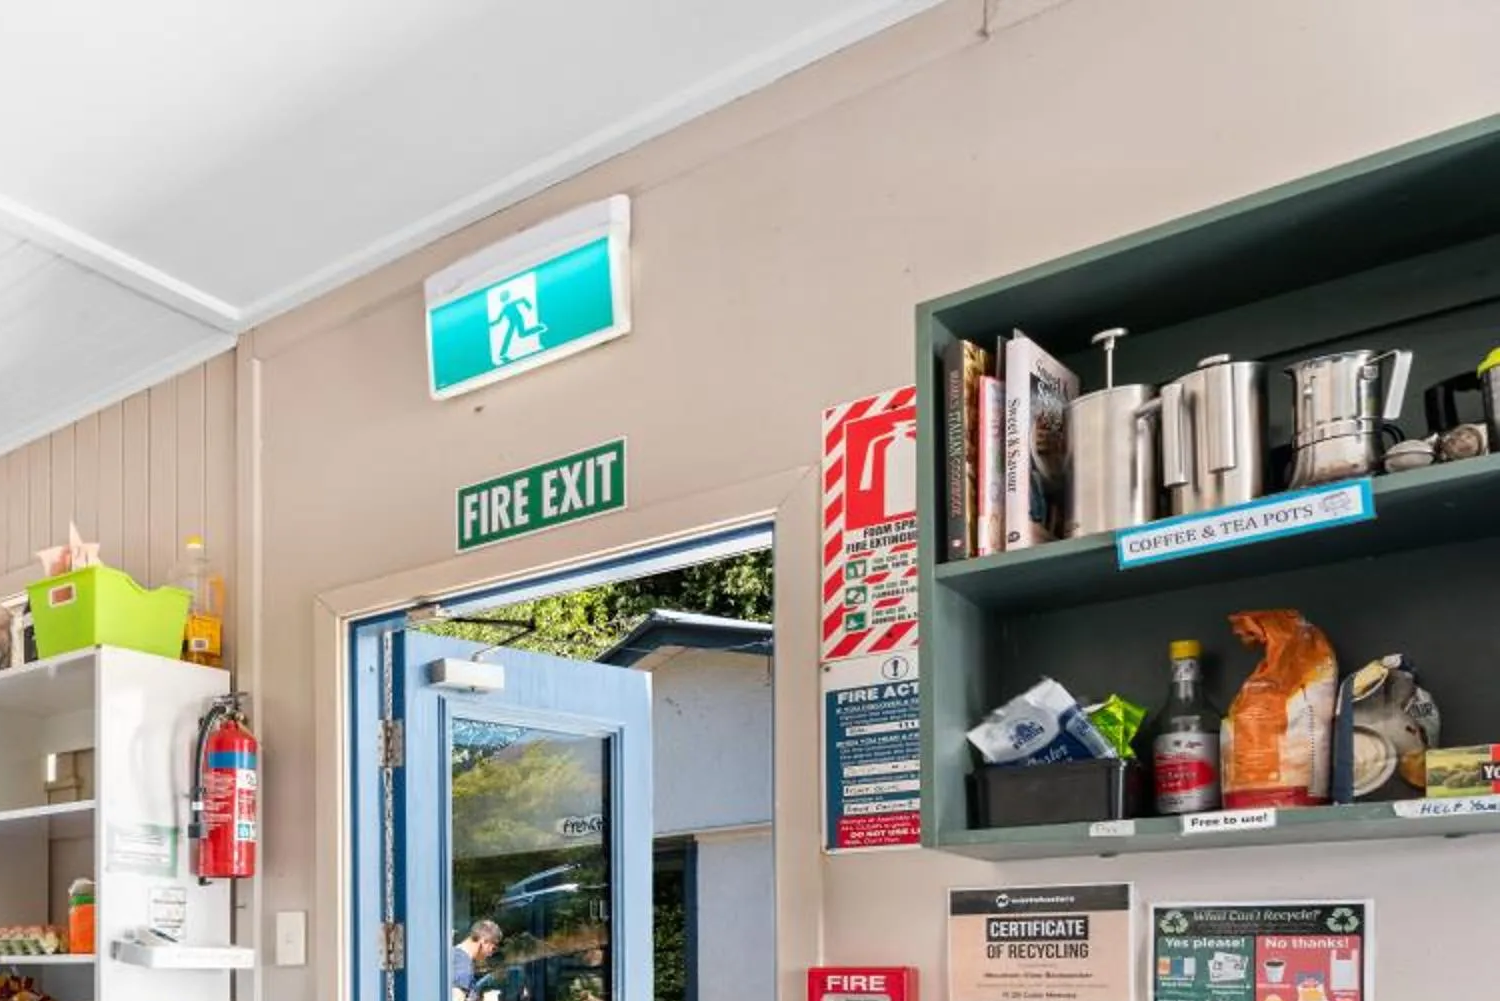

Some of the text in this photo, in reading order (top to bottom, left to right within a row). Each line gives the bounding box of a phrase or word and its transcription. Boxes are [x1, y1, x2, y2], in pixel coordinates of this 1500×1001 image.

[1007, 398, 1021, 436] Sweet
[948, 411, 961, 456] ITALIAN
[463, 451, 617, 541] FIRE EXIT
[863, 522, 892, 538] FOAM
[1129, 504, 1314, 554] COFFEE & TEA POTS
[846, 539, 868, 554] FIRE
[837, 687, 879, 705] FIRE
[1420, 800, 1463, 815] HELP
[1190, 813, 1267, 828] Free to use!
[865, 829, 885, 838] NOT
[1193, 910, 1227, 922] What
[1228, 909, 1255, 921] Can
[1263, 909, 1321, 923] Recycle?
[990, 919, 1085, 937] CERTIFICATE
[1165, 936, 1245, 951] Yes please!
[1265, 936, 1349, 949] No thanks!
[987, 943, 1089, 959] OF RECYCLING
[827, 975, 887, 991] FIRE
